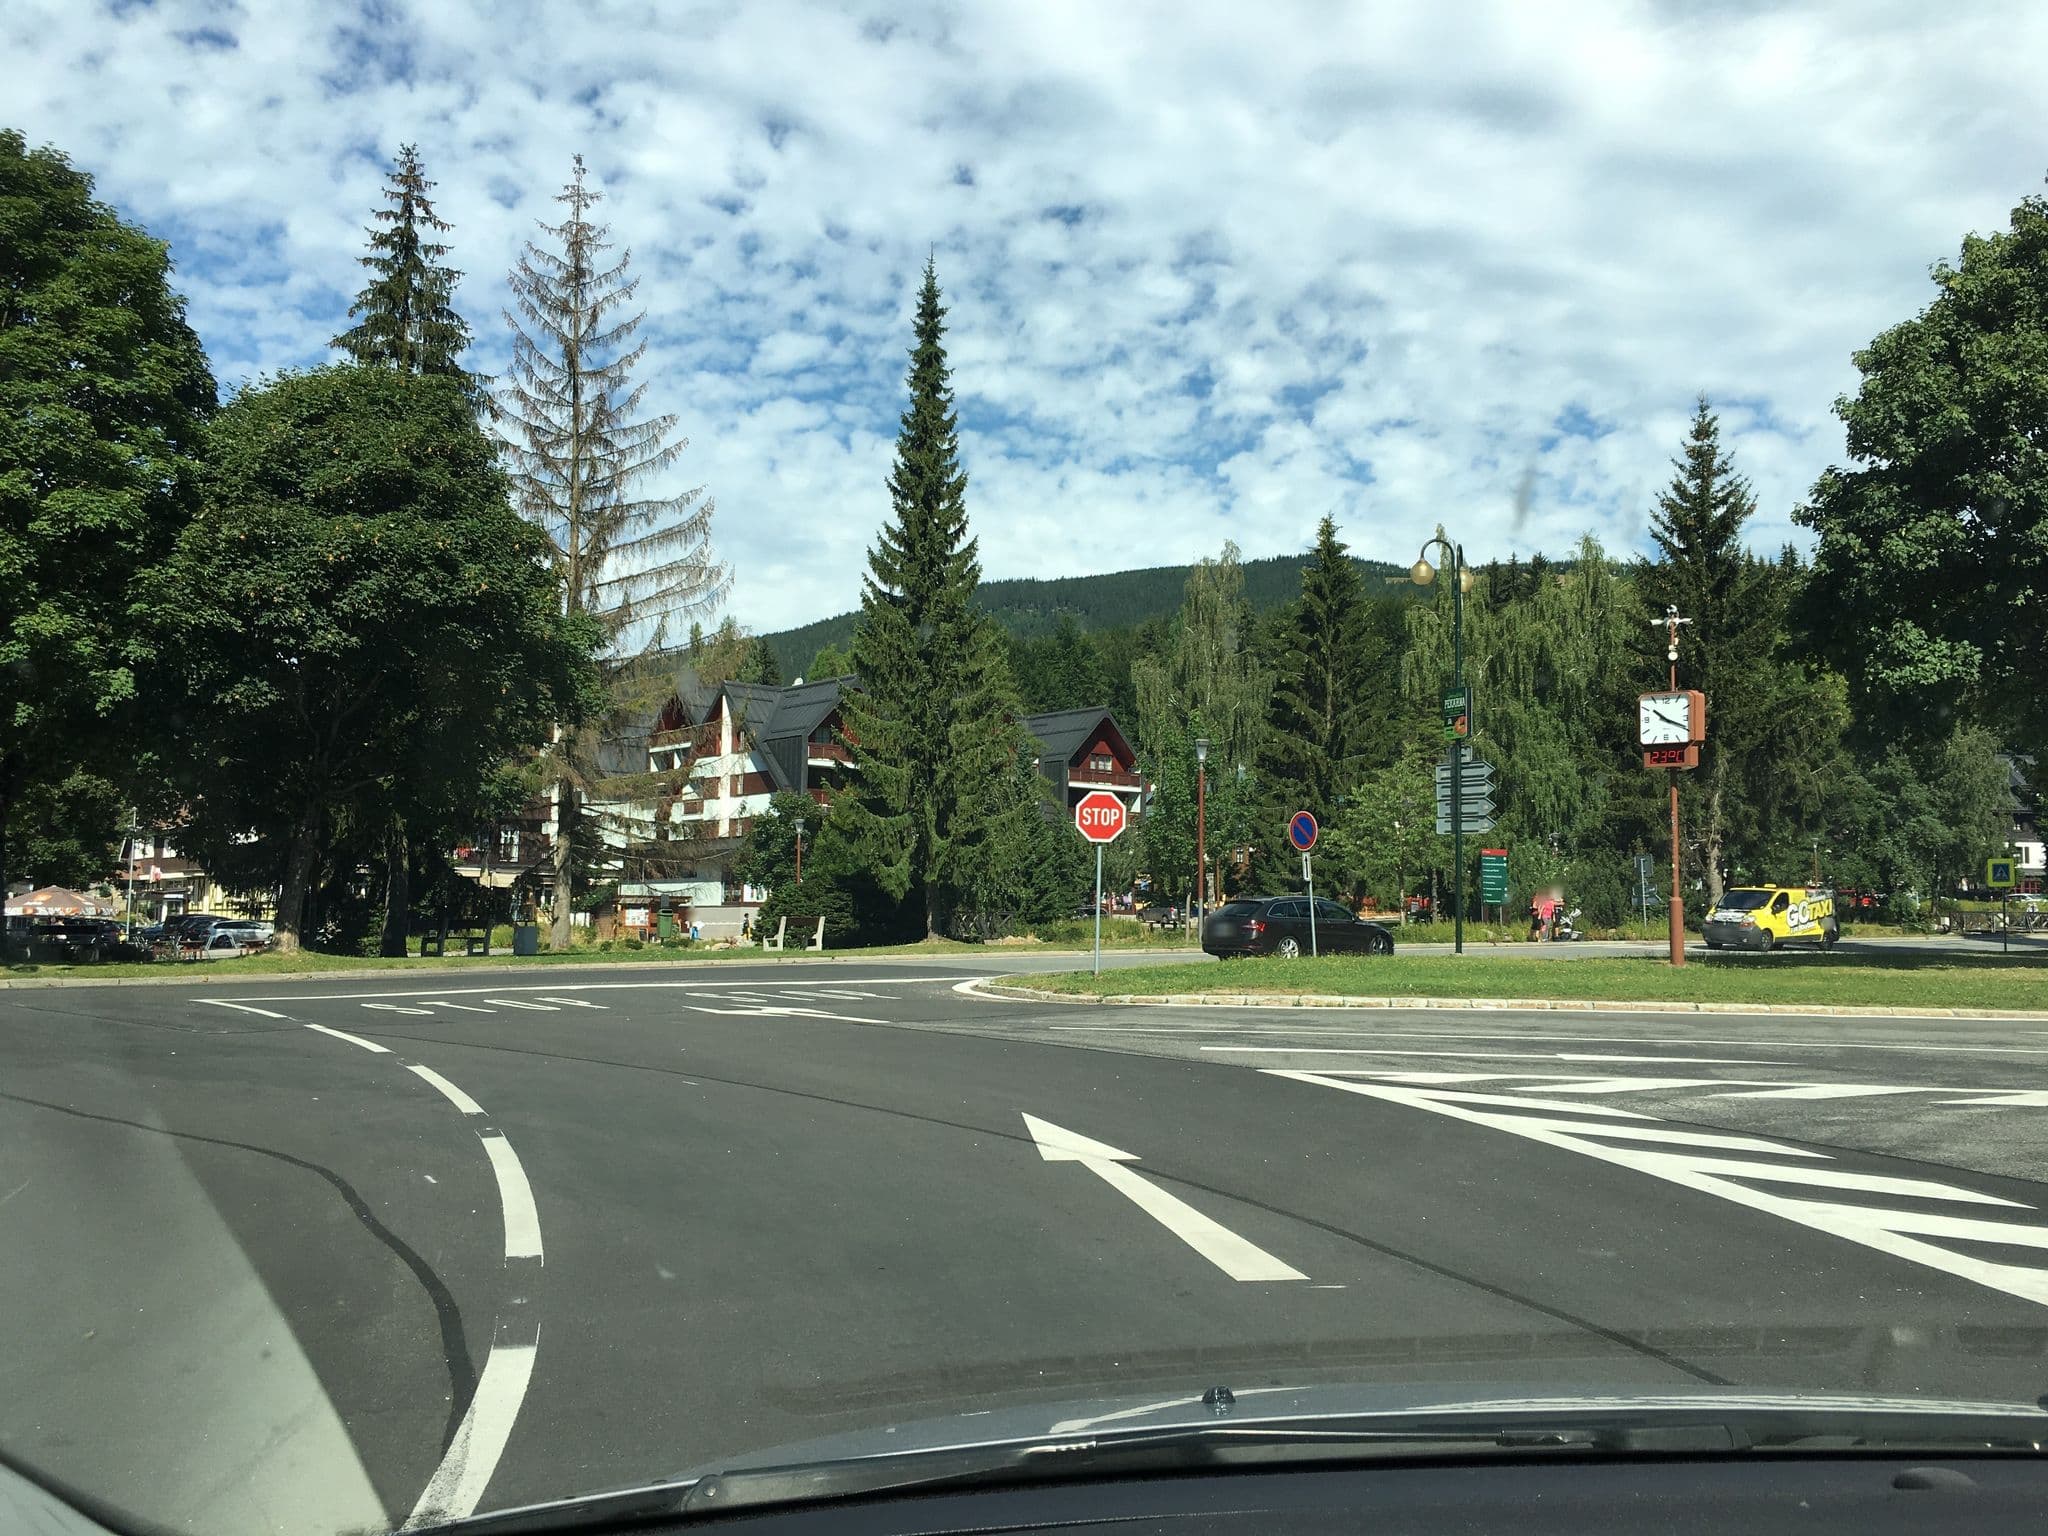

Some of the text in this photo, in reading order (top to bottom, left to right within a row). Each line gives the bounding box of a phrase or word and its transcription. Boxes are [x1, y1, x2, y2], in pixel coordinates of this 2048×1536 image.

[1662, 697, 1671, 705] 12
[1663, 733, 1670, 741] 6
[1082, 807, 1120, 826] STOP
[360, 997, 611, 1016] STOP
